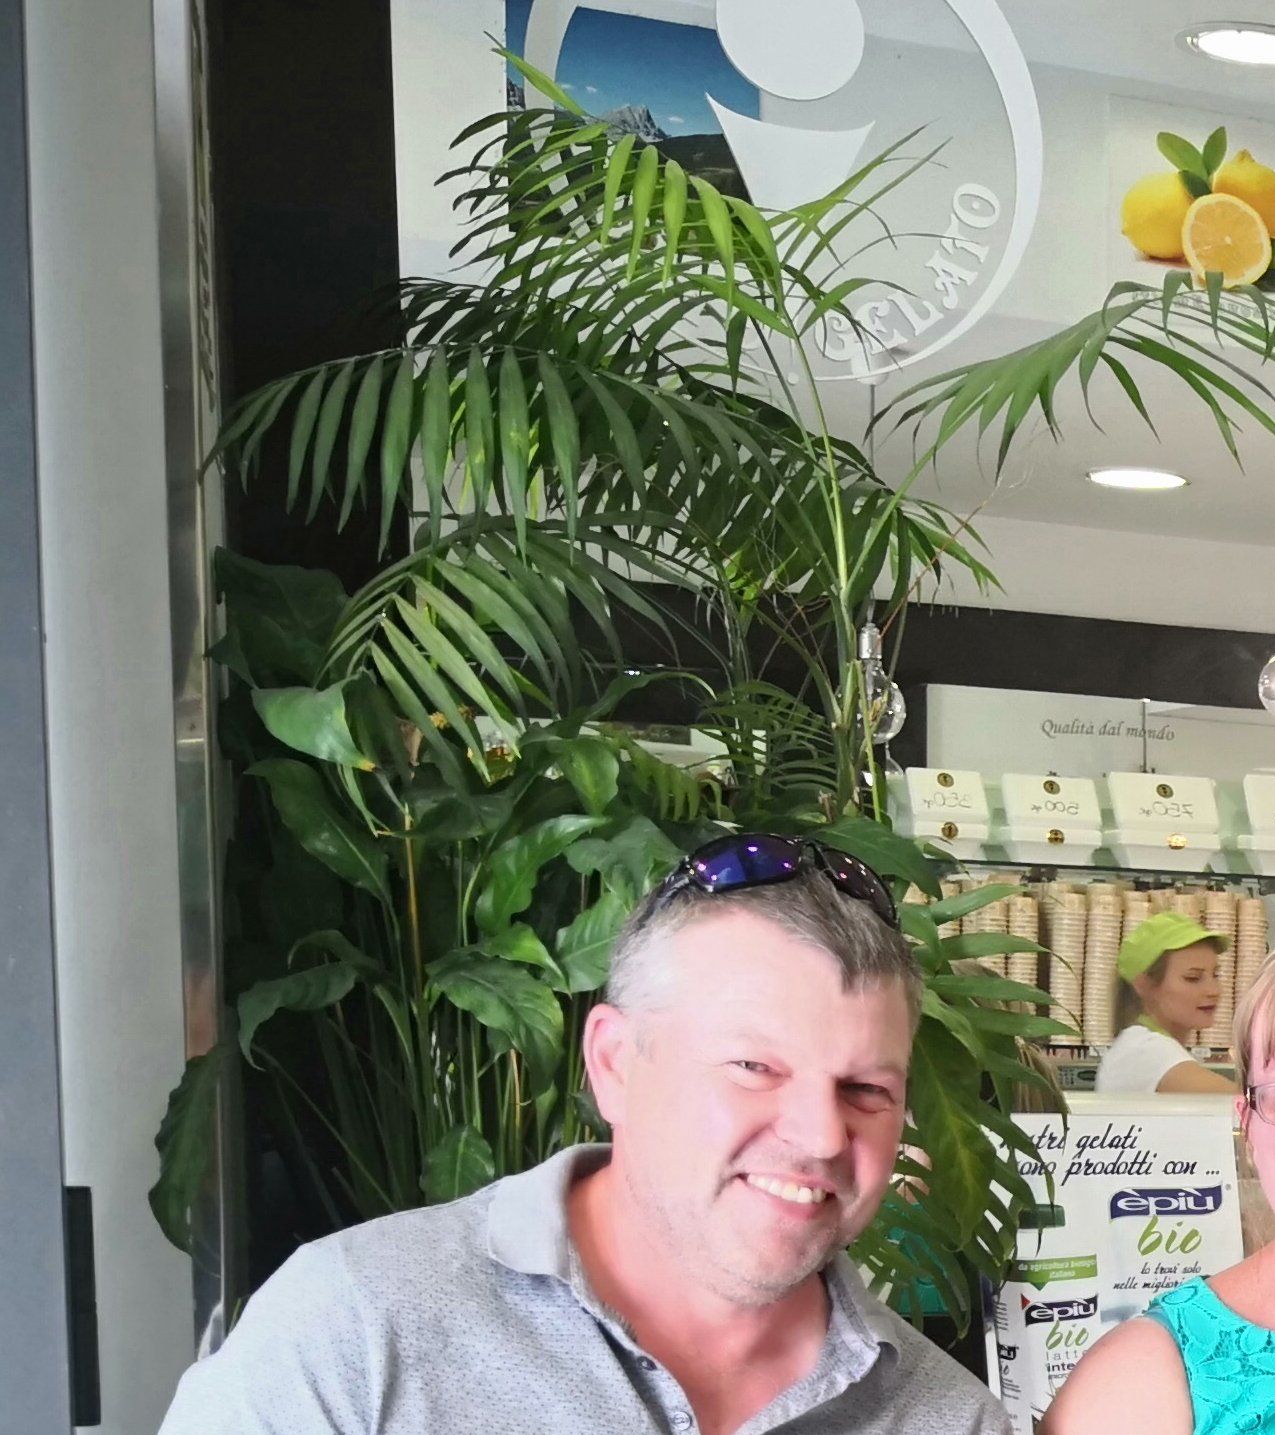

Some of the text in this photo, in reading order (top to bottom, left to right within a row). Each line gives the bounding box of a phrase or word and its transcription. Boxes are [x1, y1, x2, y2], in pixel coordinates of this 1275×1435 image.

[813, 183, 1000, 361] GELATO
[1041, 717, 1176, 742] Qualità dal mondo
[1074, 1122, 1143, 1158] gelati
[1060, 1152, 1158, 1187] prodotti
[1162, 1159, 1200, 1176] con
[1116, 1188, 1216, 1216] èpiù
[1137, 1214, 1203, 1257] bio
[1113, 1275, 1138, 1290] nelle
[1045, 1319, 1090, 1350] bio
